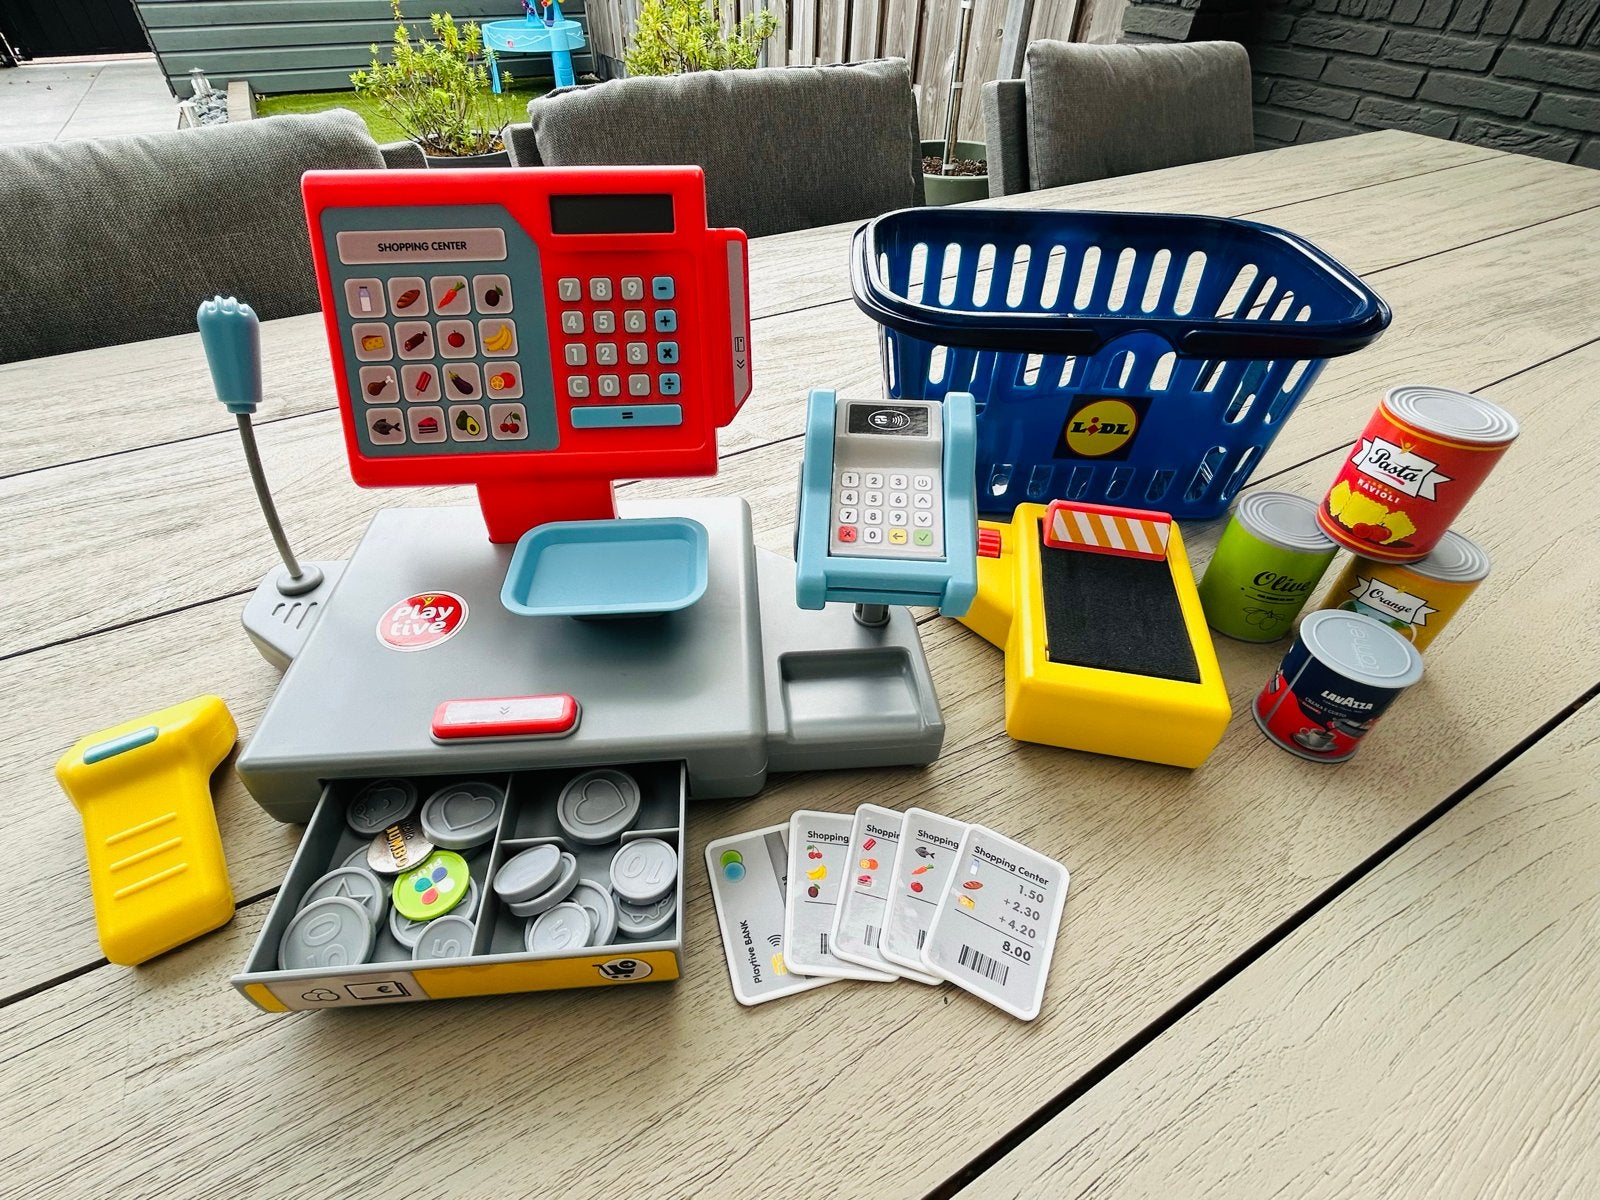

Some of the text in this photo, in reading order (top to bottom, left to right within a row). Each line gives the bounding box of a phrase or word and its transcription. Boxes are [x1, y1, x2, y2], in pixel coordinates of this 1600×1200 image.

[377, 241, 467, 253] SHOPPING CENTER
[564, 282, 573, 297] 7
[596, 282, 606, 297] 8
[627, 281, 637, 296] 9
[567, 315, 577, 329] 4
[599, 315, 608, 329] 5
[630, 315, 640, 329] 6
[571, 348, 578, 362] 1
[601, 347, 610, 361] 2
[632, 347, 641, 360] 3
[572, 381, 584, 393] C
[603, 379, 613, 393] 0
[1368, 448, 1423, 482] Pasta
[847, 476, 902, 486] 1 2 3
[846, 494, 902, 504] 4 5 6
[1357, 478, 1400, 504] RAVIOLI
[845, 511, 902, 522] 7 8 9
[869, 531, 876, 539] 0
[1253, 571, 1312, 593] Olive
[1368, 588, 1412, 614] Orange
[391, 604, 455, 621] Play
[390, 620, 447, 636] tive
[1320, 690, 1374, 711] LAVAZZA
[386, 825, 409, 868] JUMBO
[807, 830, 849, 844] Shopping
[917, 829, 959, 849] Shopping
[974, 845, 1049, 886] Shopping Center
[1019, 884, 1044, 904] 1.50
[1012, 901, 1040, 921] 2.30
[1008, 920, 1036, 939] 4.20
[740, 920, 762, 984] Playtive BANK
[1002, 940, 1031, 962] 8.00
